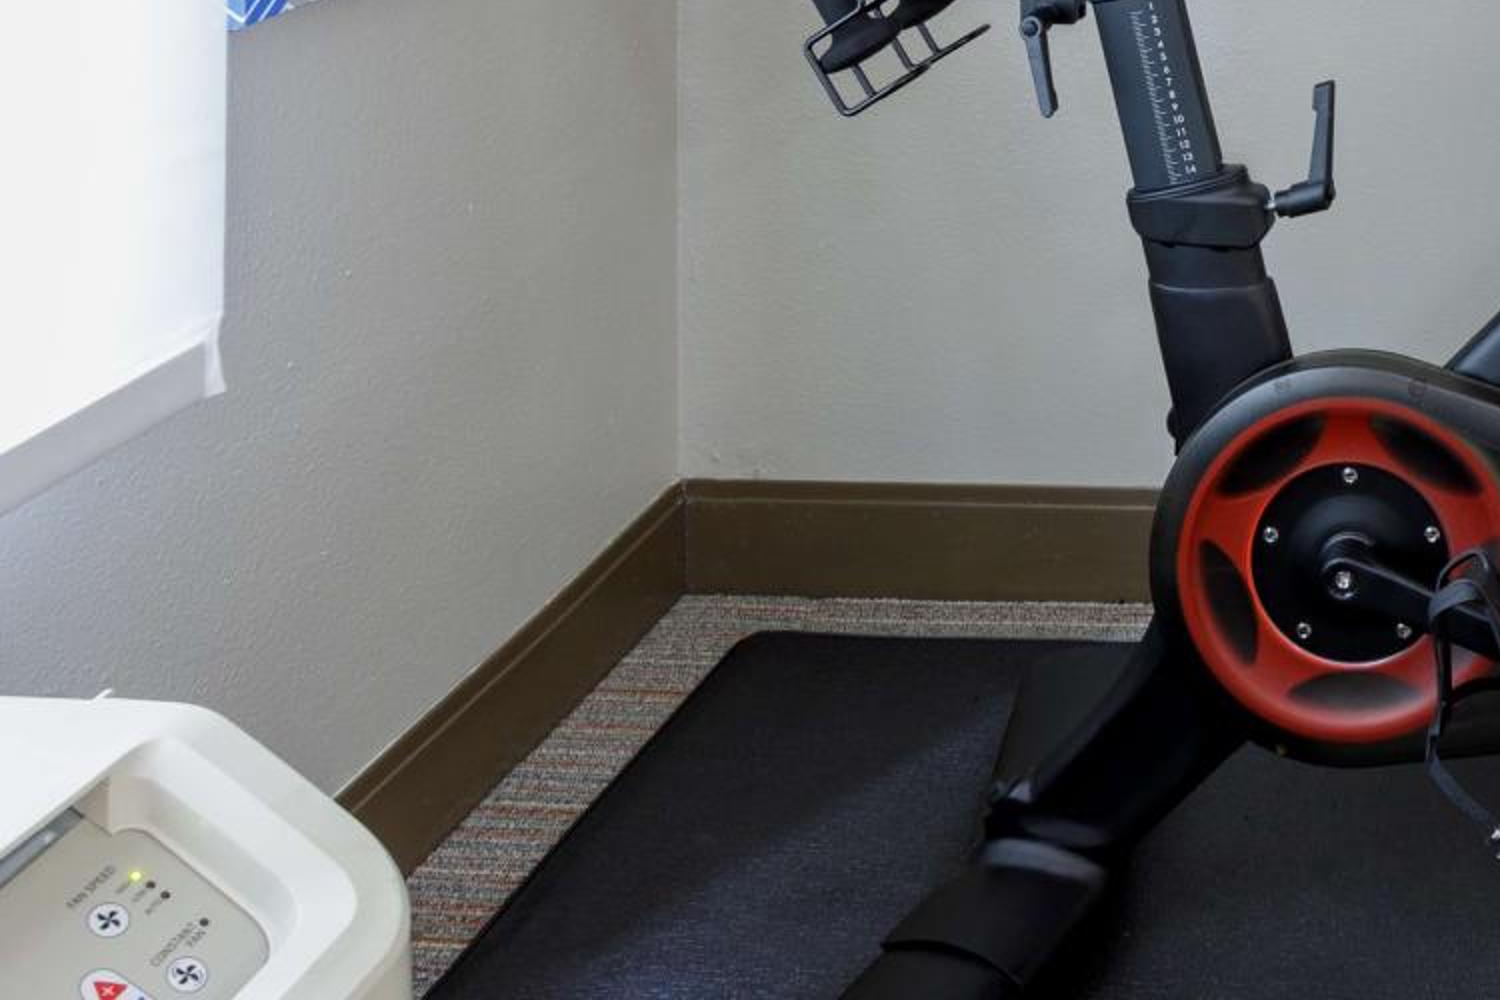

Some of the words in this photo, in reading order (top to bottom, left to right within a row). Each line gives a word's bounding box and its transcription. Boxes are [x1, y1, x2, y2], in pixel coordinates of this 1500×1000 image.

[1154, 27, 1161, 36] 3
[1165, 77, 1172, 87] 7
[1173, 114, 1184, 124] 10
[1175, 126, 1186, 136] 11
[1184, 164, 1196, 174] 14
